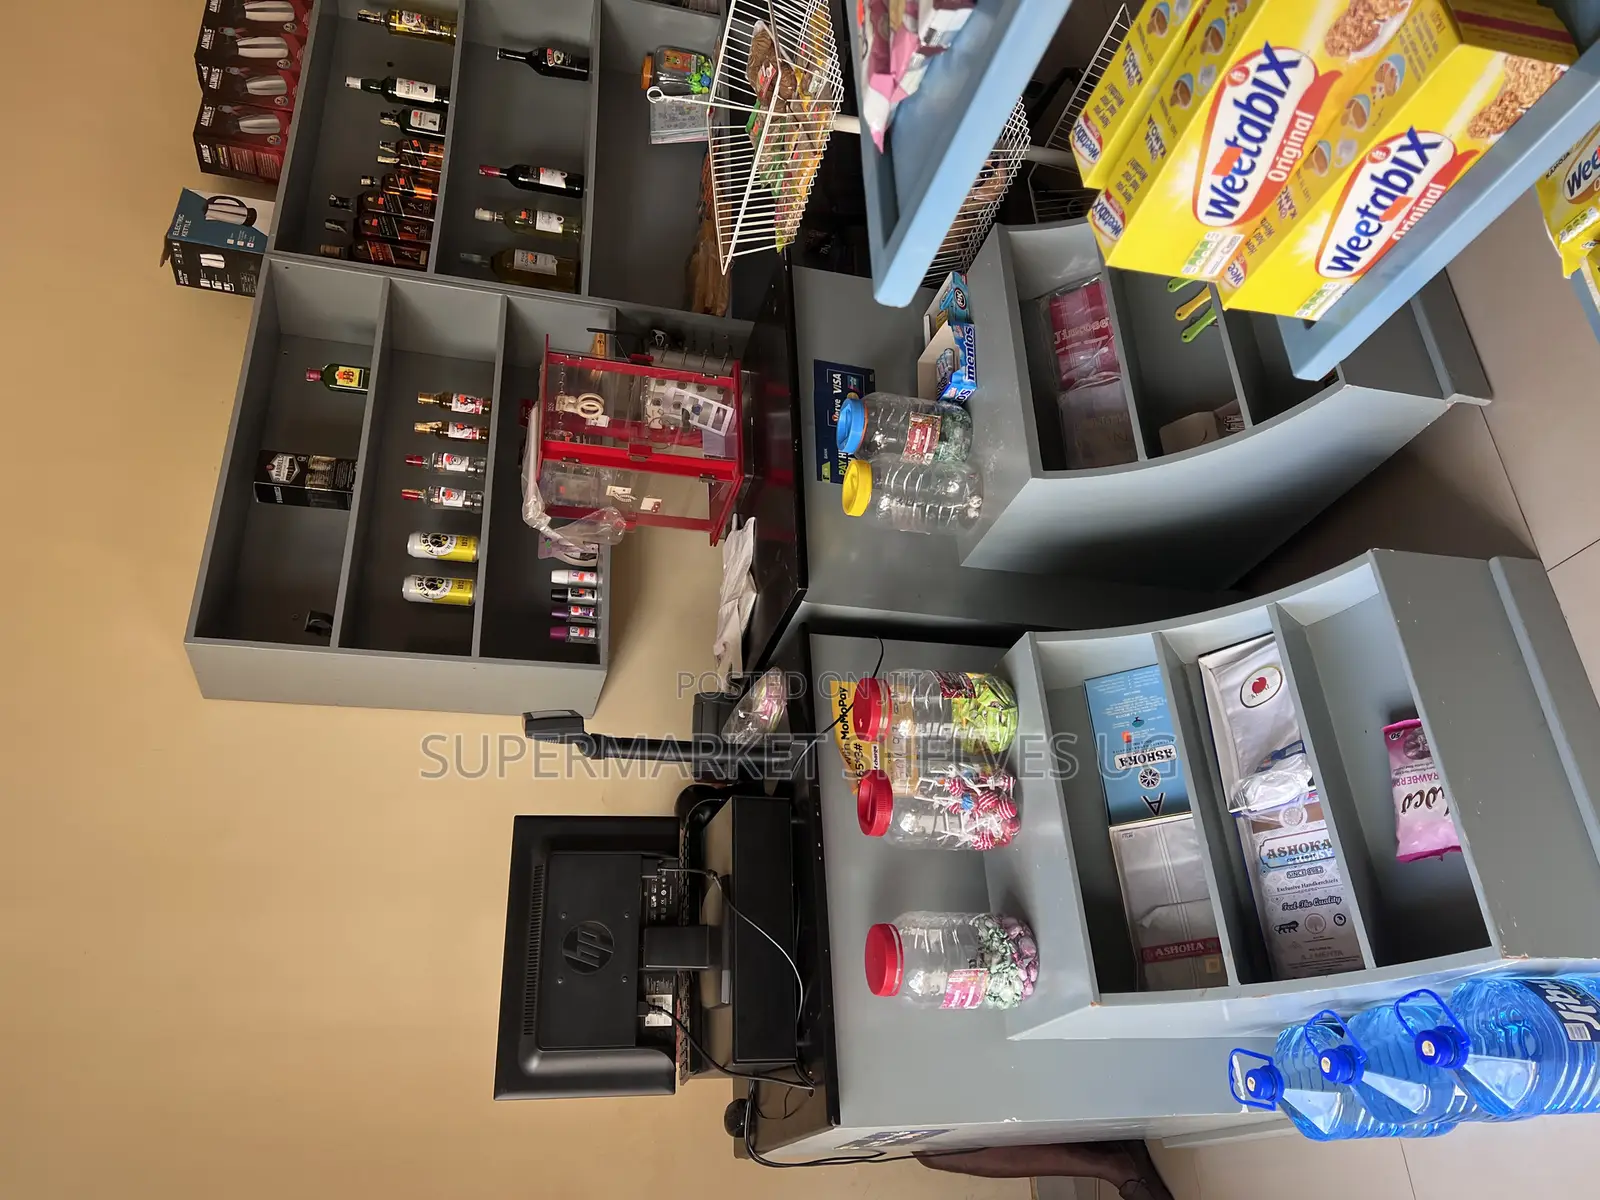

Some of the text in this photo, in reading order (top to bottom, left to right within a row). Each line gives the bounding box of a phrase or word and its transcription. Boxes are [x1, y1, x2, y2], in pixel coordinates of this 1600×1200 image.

[1125, 40, 1143, 86] KAMOJA
[1074, 120, 1100, 160] Weetabix
[1147, 113, 1167, 159] KAMOJA
[1205, 40, 1301, 221] Weetabix
[1267, 110, 1315, 183] Original
[1566, 146, 1600, 198] Wee
[1092, 198, 1123, 238] Weetabix
[1326, 125, 1445, 273] Weetabix
[1392, 182, 1447, 241] Original
[172, 213, 185, 236] ELECTRIC
[180, 219, 192, 237] KETTLE
[1227, 262, 1244, 285] Wee
[963, 325, 975, 383] mentos
[832, 373, 842, 394] VISA
[838, 461, 846, 476] PAY
[838, 686, 849, 740] MoMoPay
[1118, 747, 1174, 769] ASHOKA
[1141, 792, 1165, 816] A
[1267, 838, 1332, 860] ASHOKA
[1276, 877, 1339, 893] Exclusive Handkerchiefs
[1281, 895, 1343, 911] Feel The Quality
[562, 926, 614, 967] hp
